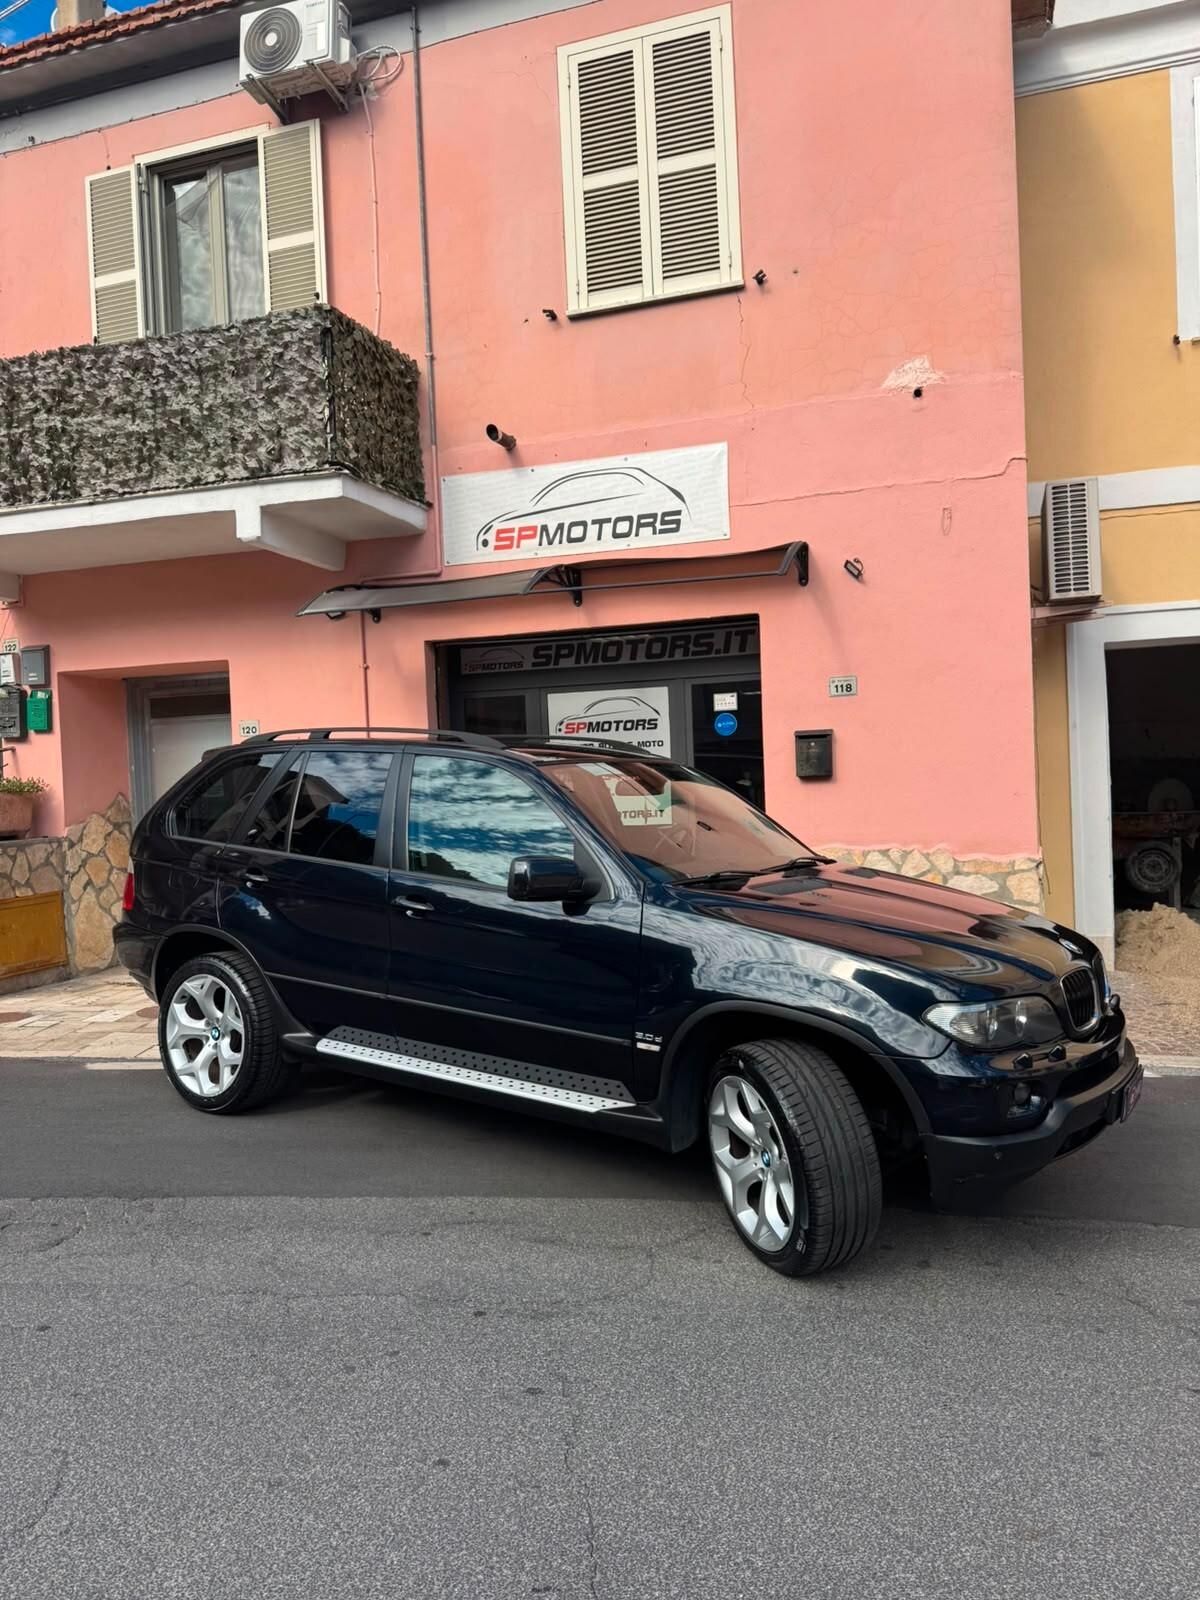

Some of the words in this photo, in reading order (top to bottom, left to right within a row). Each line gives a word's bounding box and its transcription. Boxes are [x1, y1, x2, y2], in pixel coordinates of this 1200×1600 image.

[493, 509, 682, 551] SPMOTORS
[4, 644, 17, 652] 122
[531, 629, 755, 667] SPMOTORS.IT
[834, 683, 852, 693] 118
[241, 726, 257, 735] 120
[564, 718, 659, 735] SPMOTORS
[637, 740, 664, 749] MOTO
